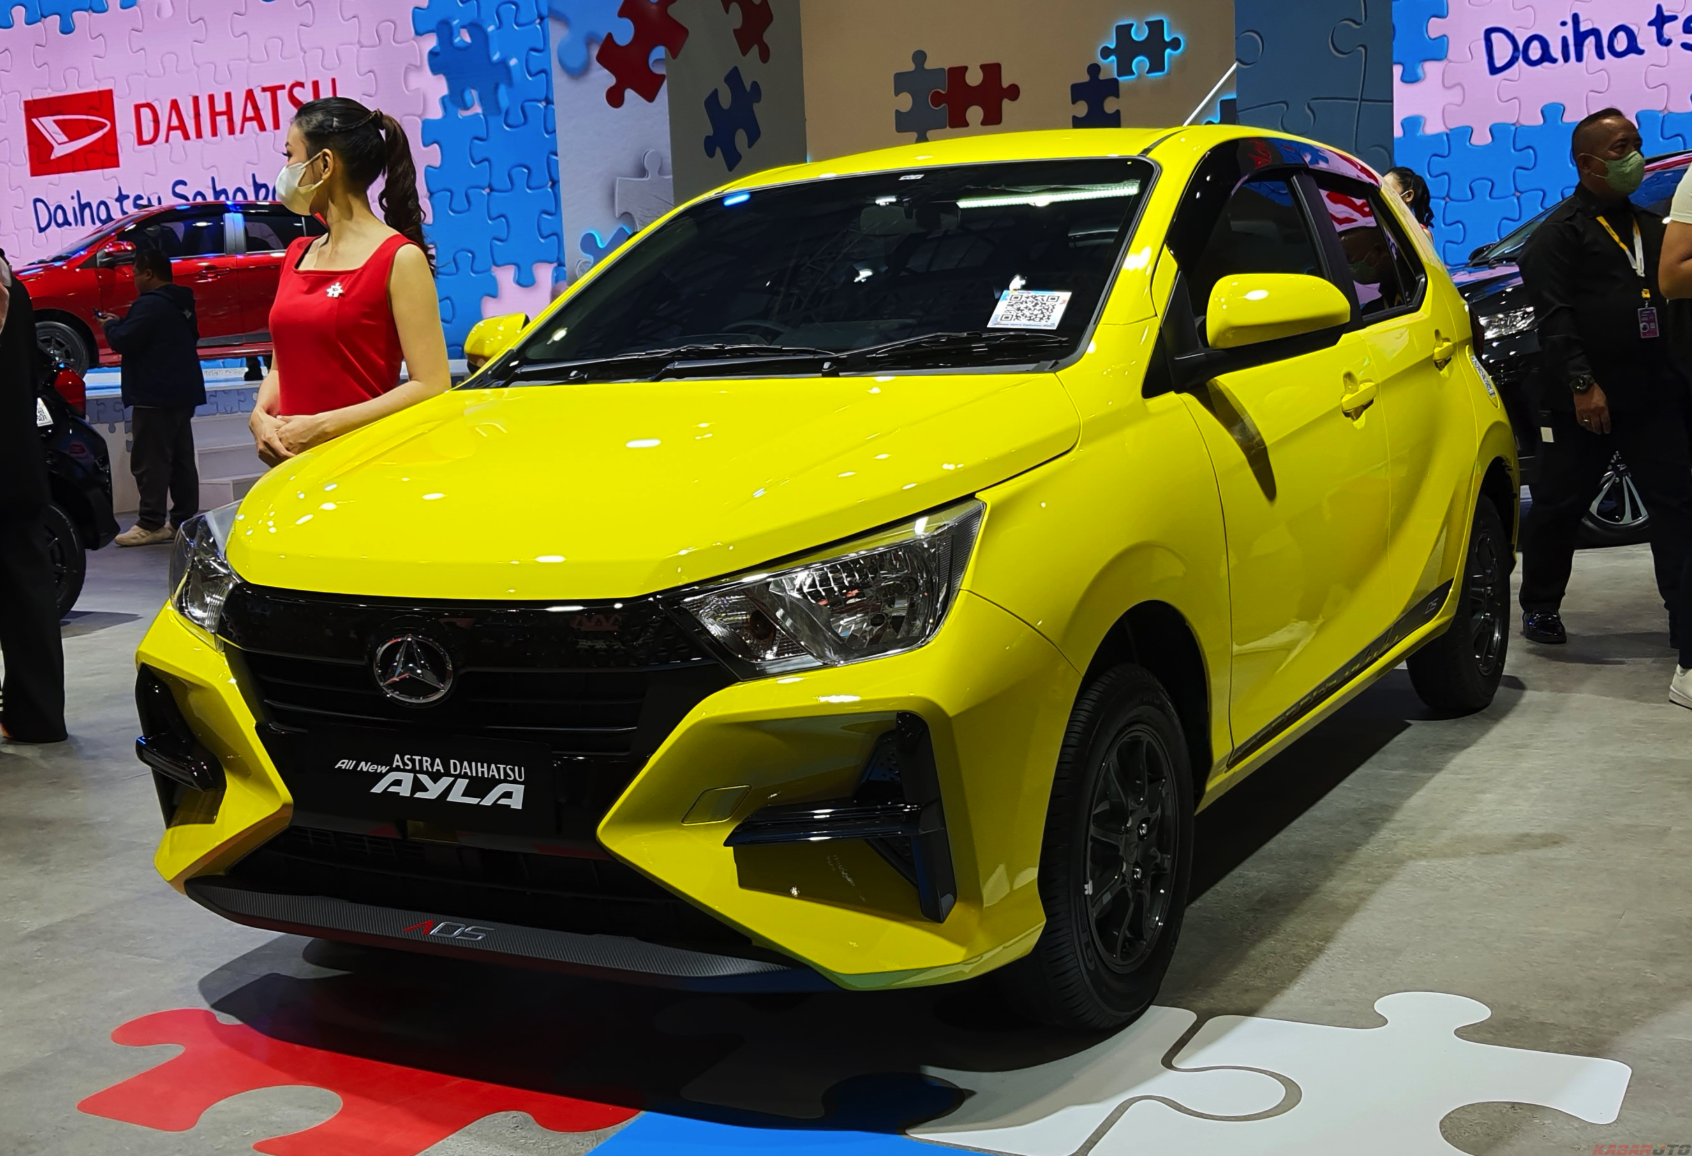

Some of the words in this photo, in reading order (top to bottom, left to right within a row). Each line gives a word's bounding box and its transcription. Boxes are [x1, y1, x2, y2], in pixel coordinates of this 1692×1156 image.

[334, 758, 356, 770] All
[357, 761, 390, 774] New
[392, 753, 445, 773] ASTRA
[449, 759, 525, 782] DAIHATSU
[369, 771, 525, 810] AYLA
